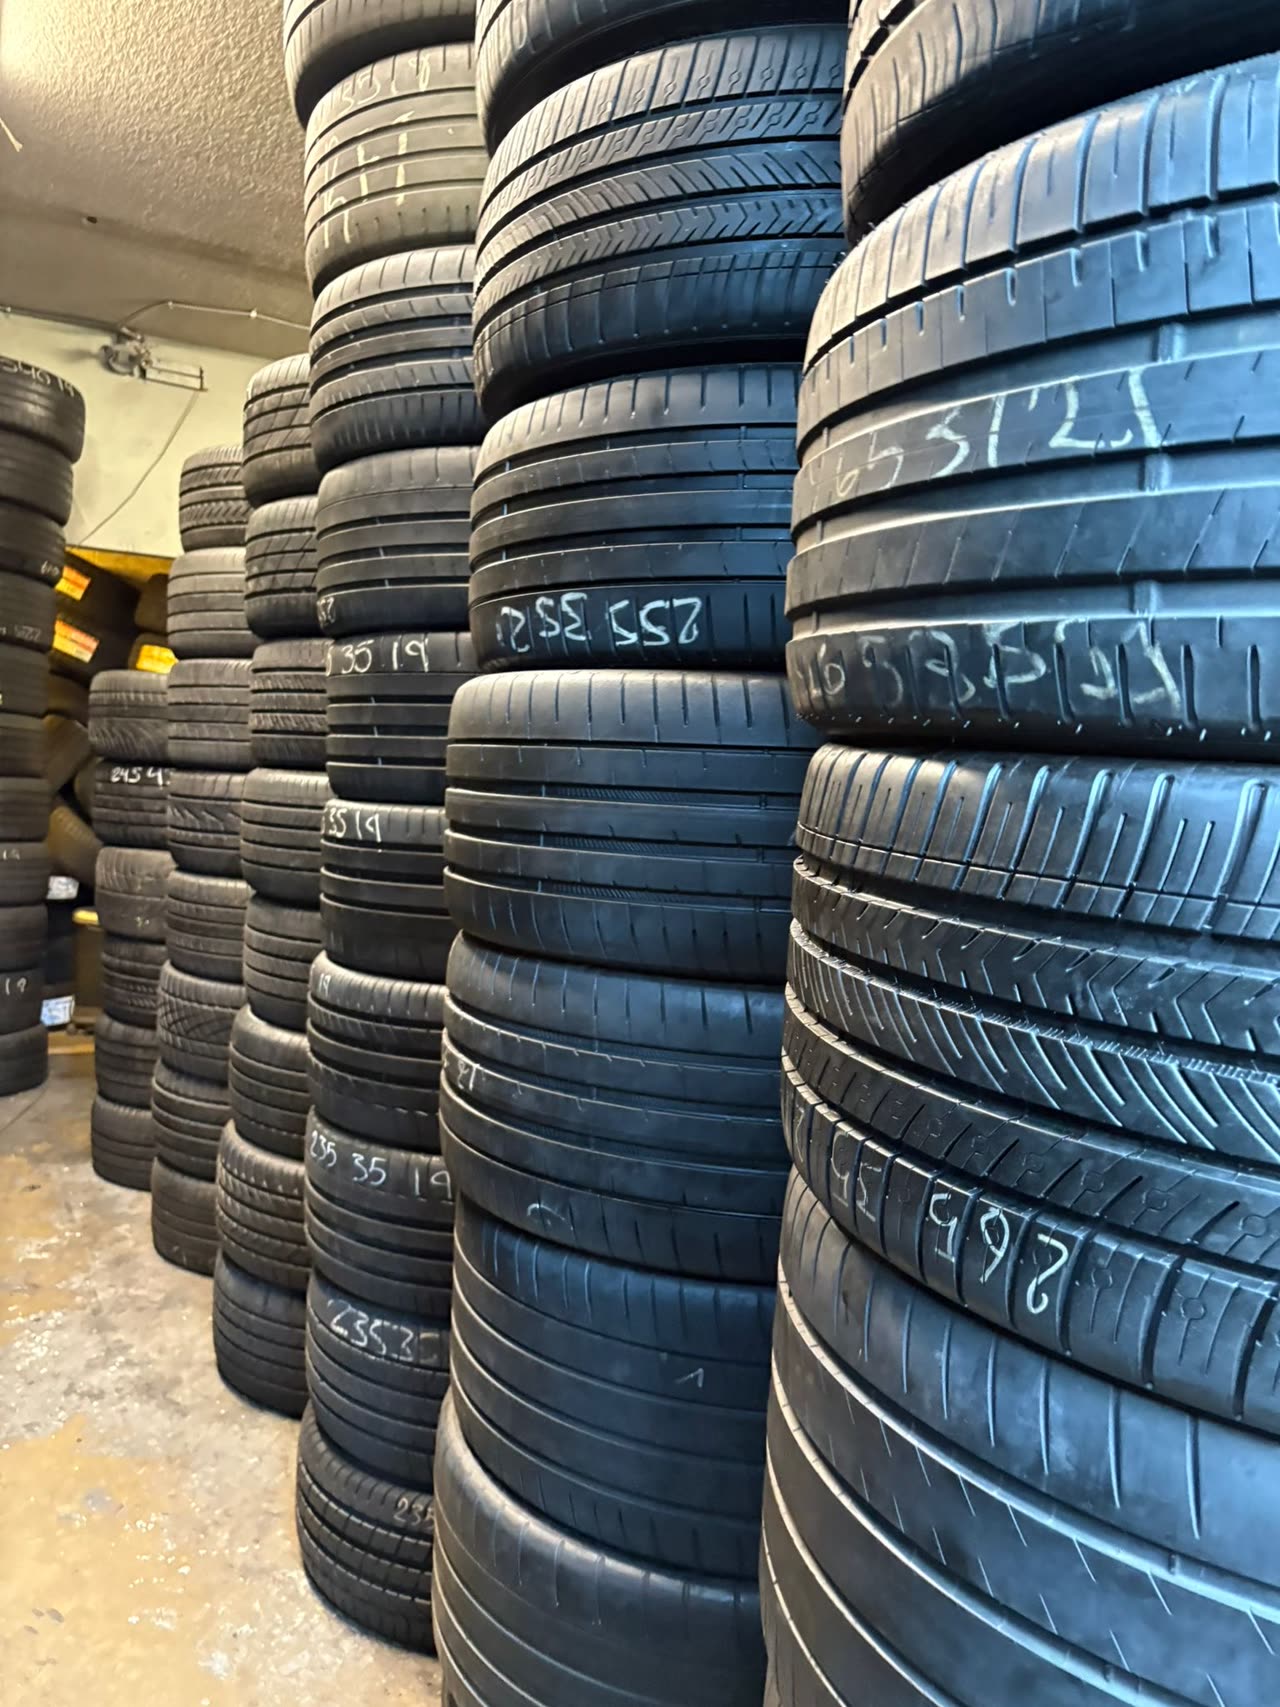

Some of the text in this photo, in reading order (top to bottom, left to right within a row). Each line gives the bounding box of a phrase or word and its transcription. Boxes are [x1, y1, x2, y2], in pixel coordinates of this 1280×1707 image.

[605, 597, 702, 646] 255
[341, 639, 375, 674] 35
[392, 637, 429, 673] 19
[110, 766, 143, 783] 245
[355, 810, 382, 843] 19
[310, 1130, 452, 1199] 235 35 19
[909, 1191, 1069, 1315] 265
